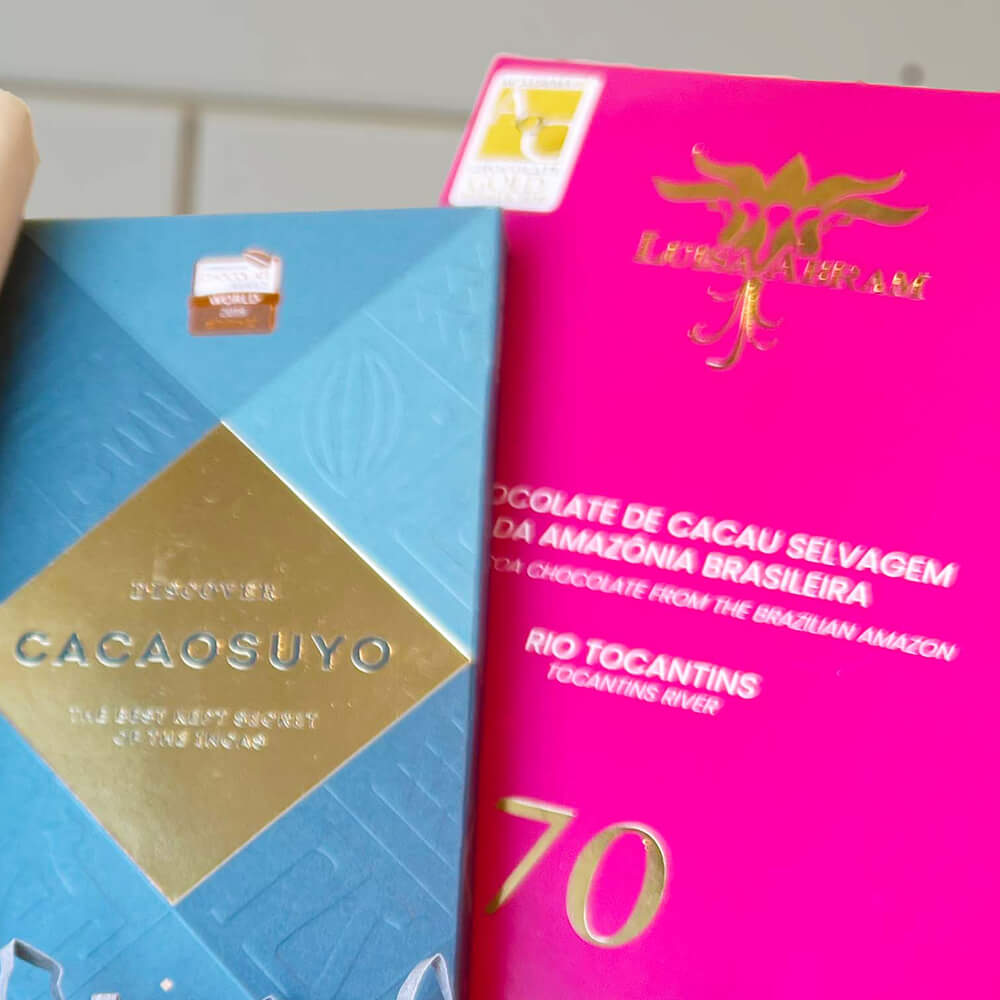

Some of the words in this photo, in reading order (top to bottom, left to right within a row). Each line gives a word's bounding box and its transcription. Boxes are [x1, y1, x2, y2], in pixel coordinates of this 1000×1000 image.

[492, 482, 621, 527] OCOLATE
[620, 501, 666, 534] DE
[667, 511, 786, 555] CACAU
[785, 532, 961, 588] SELVAGEM
[492, 516, 537, 545] DA
[538, 522, 699, 575] AMAZÔNIA
[702, 551, 874, 609] BRASILEIRA
[129, 580, 281, 602] DISCOVER
[526, 559, 650, 600] CHOCOLATE
[648, 582, 711, 612] FROM
[712, 595, 753, 621] THE
[751, 603, 859, 642] BRAZILIAN
[856, 625, 960, 663] AMAZON
[13, 629, 394, 675] CACAOSUYO
[525, 626, 581, 661] RIO
[585, 637, 764, 700] TOCANTINS
[68, 705, 109, 726] THE
[113, 705, 167, 727] BEST
[173, 706, 229, 727] KEPT
[232, 708, 320, 729] SECRET
[546, 661, 662, 703] TOCANTINS
[660, 685, 724, 716] RIVER
[112, 729, 143, 748] OF
[147, 729, 189, 749] THE
[193, 730, 268, 751] INCAS
[485, 796, 668, 949] 70
